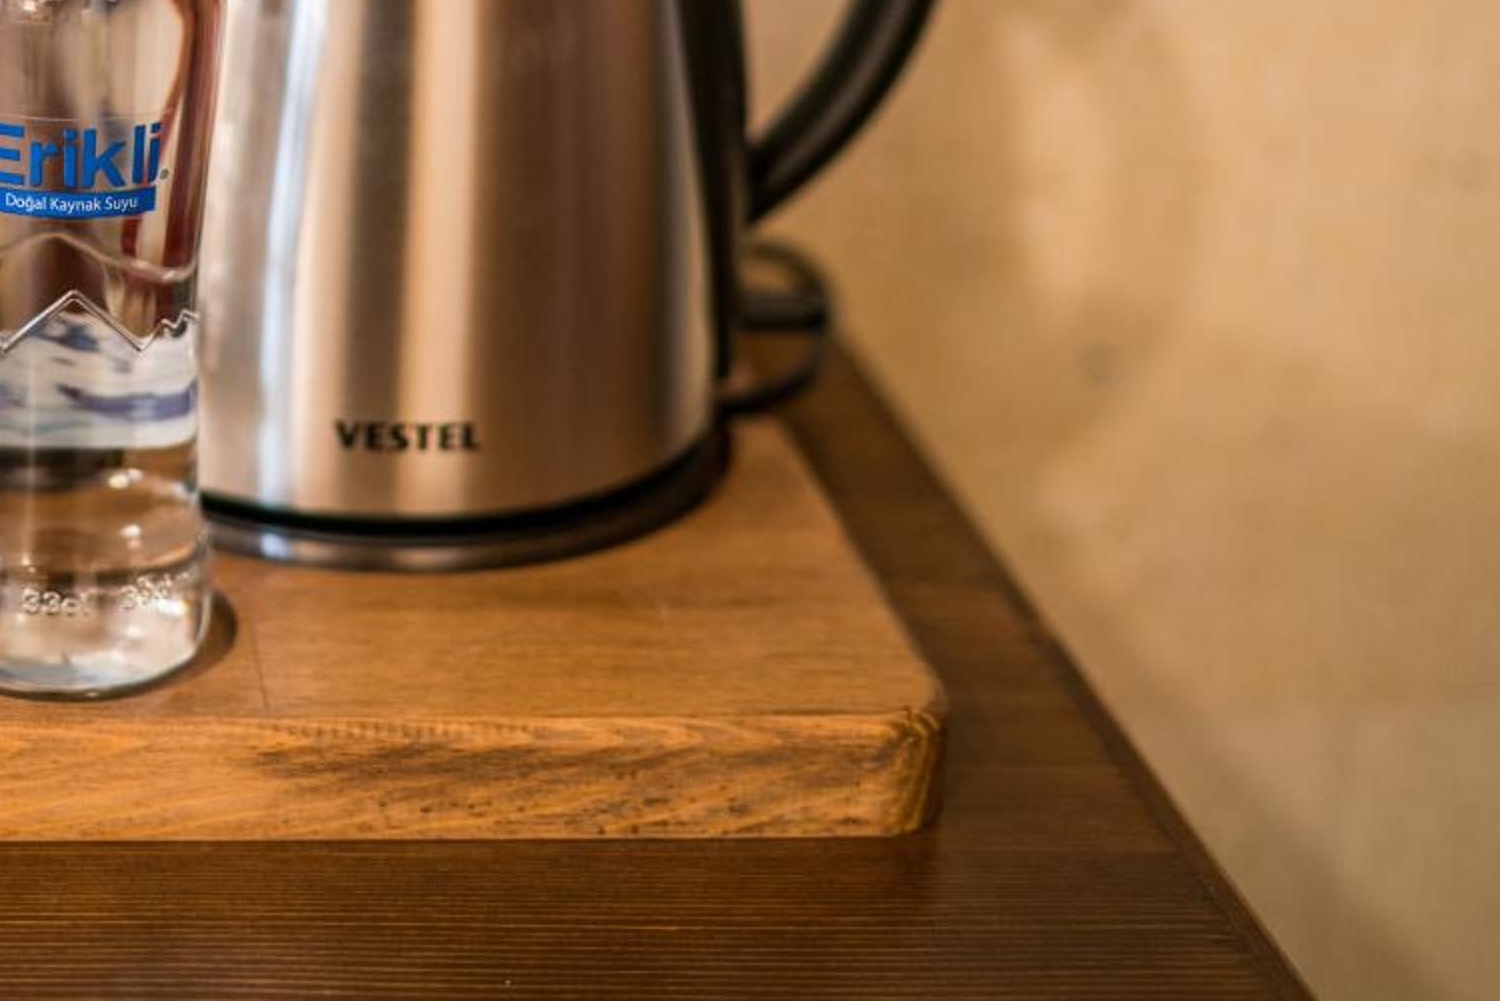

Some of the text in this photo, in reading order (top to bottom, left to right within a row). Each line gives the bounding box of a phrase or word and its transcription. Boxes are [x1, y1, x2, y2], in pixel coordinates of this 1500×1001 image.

[5, 191, 138, 214] Doğal Kaynak Suyu
[335, 419, 481, 451] VESTEL
